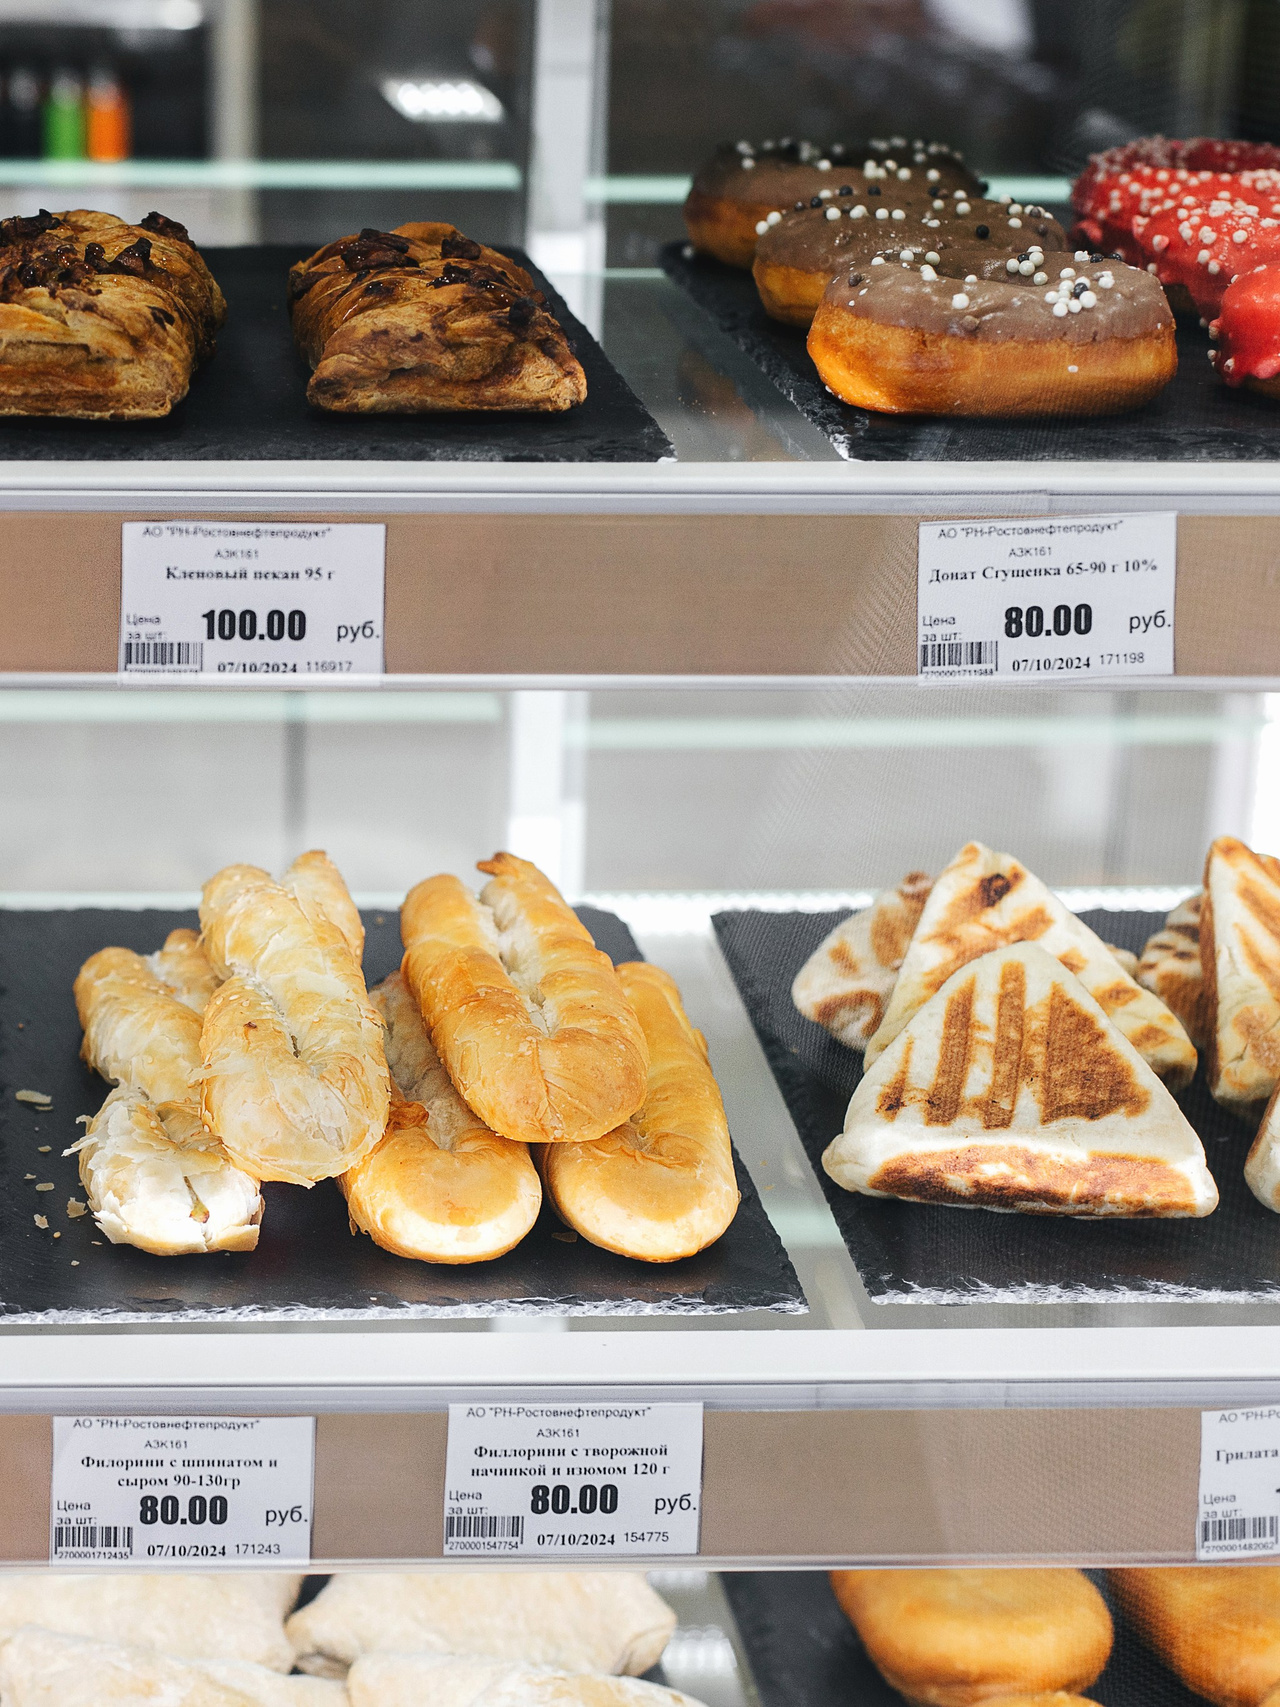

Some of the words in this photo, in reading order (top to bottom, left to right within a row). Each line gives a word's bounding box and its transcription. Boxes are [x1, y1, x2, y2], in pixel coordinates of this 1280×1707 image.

[143, 527, 163, 537] АО
[937, 527, 958, 539] АО
[1008, 547, 1052, 558] АЗК161
[166, 566, 248, 580] Кленовый
[253, 570, 299, 580] пекан
[304, 567, 322, 580] 95
[327, 570, 335, 580] г
[928, 569, 977, 585] Донат
[982, 566, 1061, 582] Сгущенка
[1066, 561, 1106, 576] 65-90
[1111, 564, 1119, 573] г
[1124, 559, 1158, 573] 10%
[126, 614, 161, 625] Цена
[922, 615, 956, 626] Цена
[1004, 603, 1093, 638] 80.00
[1129, 610, 1172, 633] руб.
[202, 609, 306, 641] 100.00
[336, 620, 380, 642] руб.
[127, 631, 141, 640] за
[922, 633, 937, 642] за
[940, 632, 962, 642] шт:
[217, 662, 298, 674] 07/10/2024
[306, 661, 353, 673] 116917
[1012, 656, 1091, 672] 07/10/2024
[1099, 652, 1145, 664] 171198
[466, 1407, 486, 1418] АО
[489, 1406, 652, 1420] "РН-Ростовнефтепродукт"
[1219, 1413, 1238, 1423] АО
[73, 1419, 93, 1429] АО
[96, 1419, 261, 1432] "РН-Ростовнефтепродукт"
[536, 1428, 580, 1438] АЗК161
[144, 1439, 189, 1449] АЗК161
[474, 1446, 566, 1460] Филлорини
[571, 1447, 579, 1457] с
[584, 1444, 668, 1460] творожной
[81, 1455, 165, 1471] Филорини
[170, 1458, 177, 1468] с
[181, 1458, 263, 1468] шпинатом
[269, 1458, 277, 1468] и
[471, 1464, 546, 1477] начинкой
[551, 1466, 561, 1476] и
[566, 1465, 628, 1476] изюмом
[632, 1463, 657, 1476] 120
[662, 1465, 670, 1475] г
[117, 1476, 168, 1491] сыром
[173, 1475, 241, 1490] 90-130гр
[449, 1490, 482, 1501] Цена
[530, 1483, 619, 1515] 80.00
[654, 1493, 697, 1515] руб.
[1203, 1494, 1237, 1505] Цена
[56, 1500, 91, 1511] Цена
[139, 1494, 228, 1525] 80.00
[265, 1504, 308, 1526] руб.
[448, 1506, 463, 1515] за
[466, 1505, 488, 1515] шт:
[1203, 1510, 1218, 1520] за
[56, 1516, 71, 1525] за
[75, 1516, 97, 1526] шт:
[537, 1533, 616, 1546] 07/10/2024
[624, 1531, 670, 1543] 154775
[147, 1544, 227, 1558] 07/10/2024
[235, 1543, 281, 1555] 171243
[448, 1541, 519, 1550] 2700001547754
[58, 1551, 130, 1560] 2700001712435
